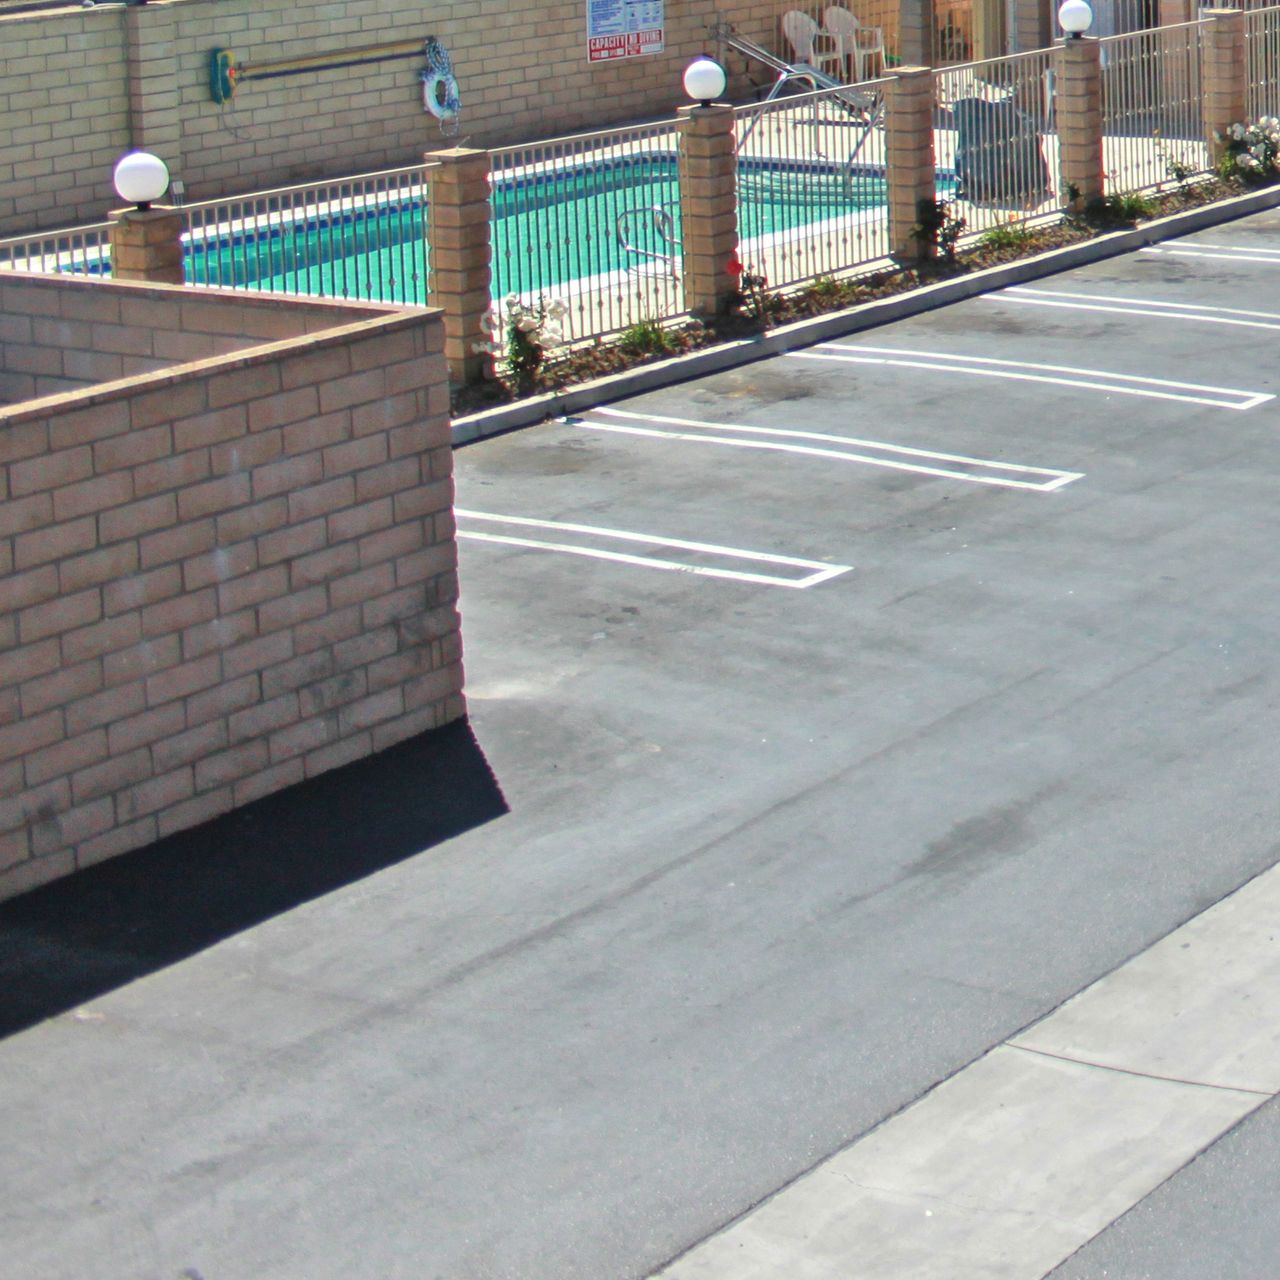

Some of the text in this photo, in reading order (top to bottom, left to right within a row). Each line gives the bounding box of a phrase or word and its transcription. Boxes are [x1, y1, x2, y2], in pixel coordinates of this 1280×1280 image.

[591, 35, 625, 50] CAPACITY
[629, 31, 660, 44] NO DIVING
